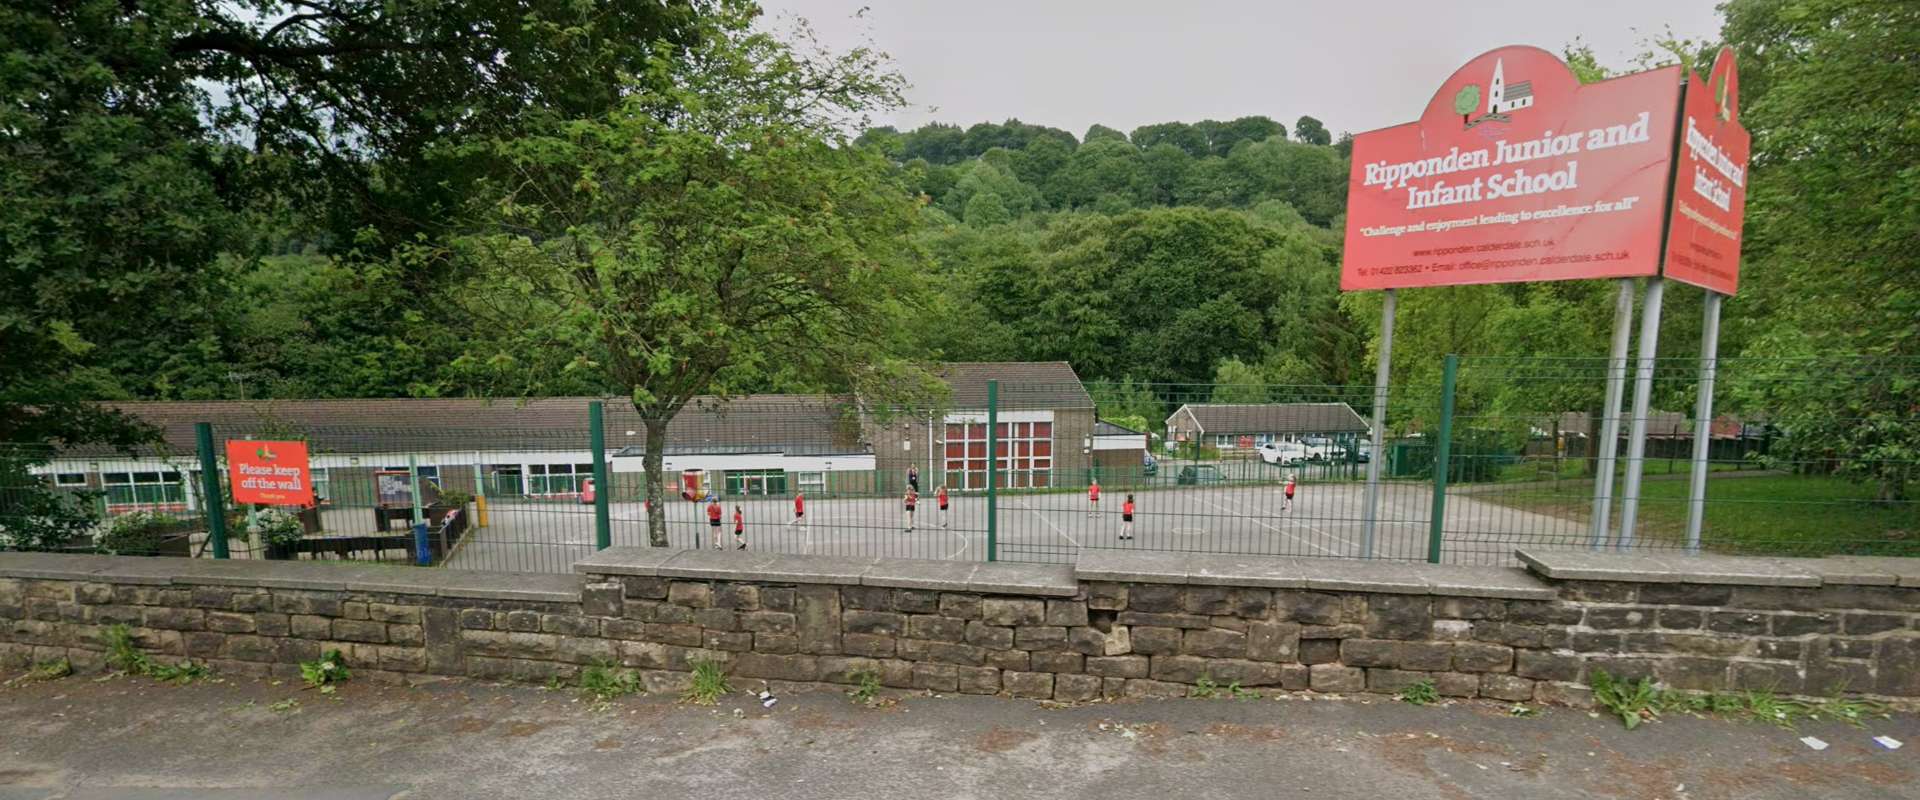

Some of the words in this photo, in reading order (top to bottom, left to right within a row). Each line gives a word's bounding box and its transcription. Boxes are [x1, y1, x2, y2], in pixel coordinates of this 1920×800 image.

[1364, 147, 1490, 188] Ripponden
[1495, 130, 1583, 165] Junior
[1587, 112, 1649, 150] and
[1405, 177, 1483, 210] Infant
[1486, 161, 1578, 199] School
[1407, 221, 1425, 233] and
[1426, 217, 1478, 231] enjoyment
[1480, 212, 1519, 224] leading
[1520, 209, 1532, 220] to
[1533, 205, 1592, 219] excellence
[1594, 200, 1612, 213] for
[240, 463, 272, 474] Please
[273, 463, 300, 479] keep
[242, 477, 256, 489] off
[257, 478, 277, 489] the
[277, 476, 303, 490] wall
